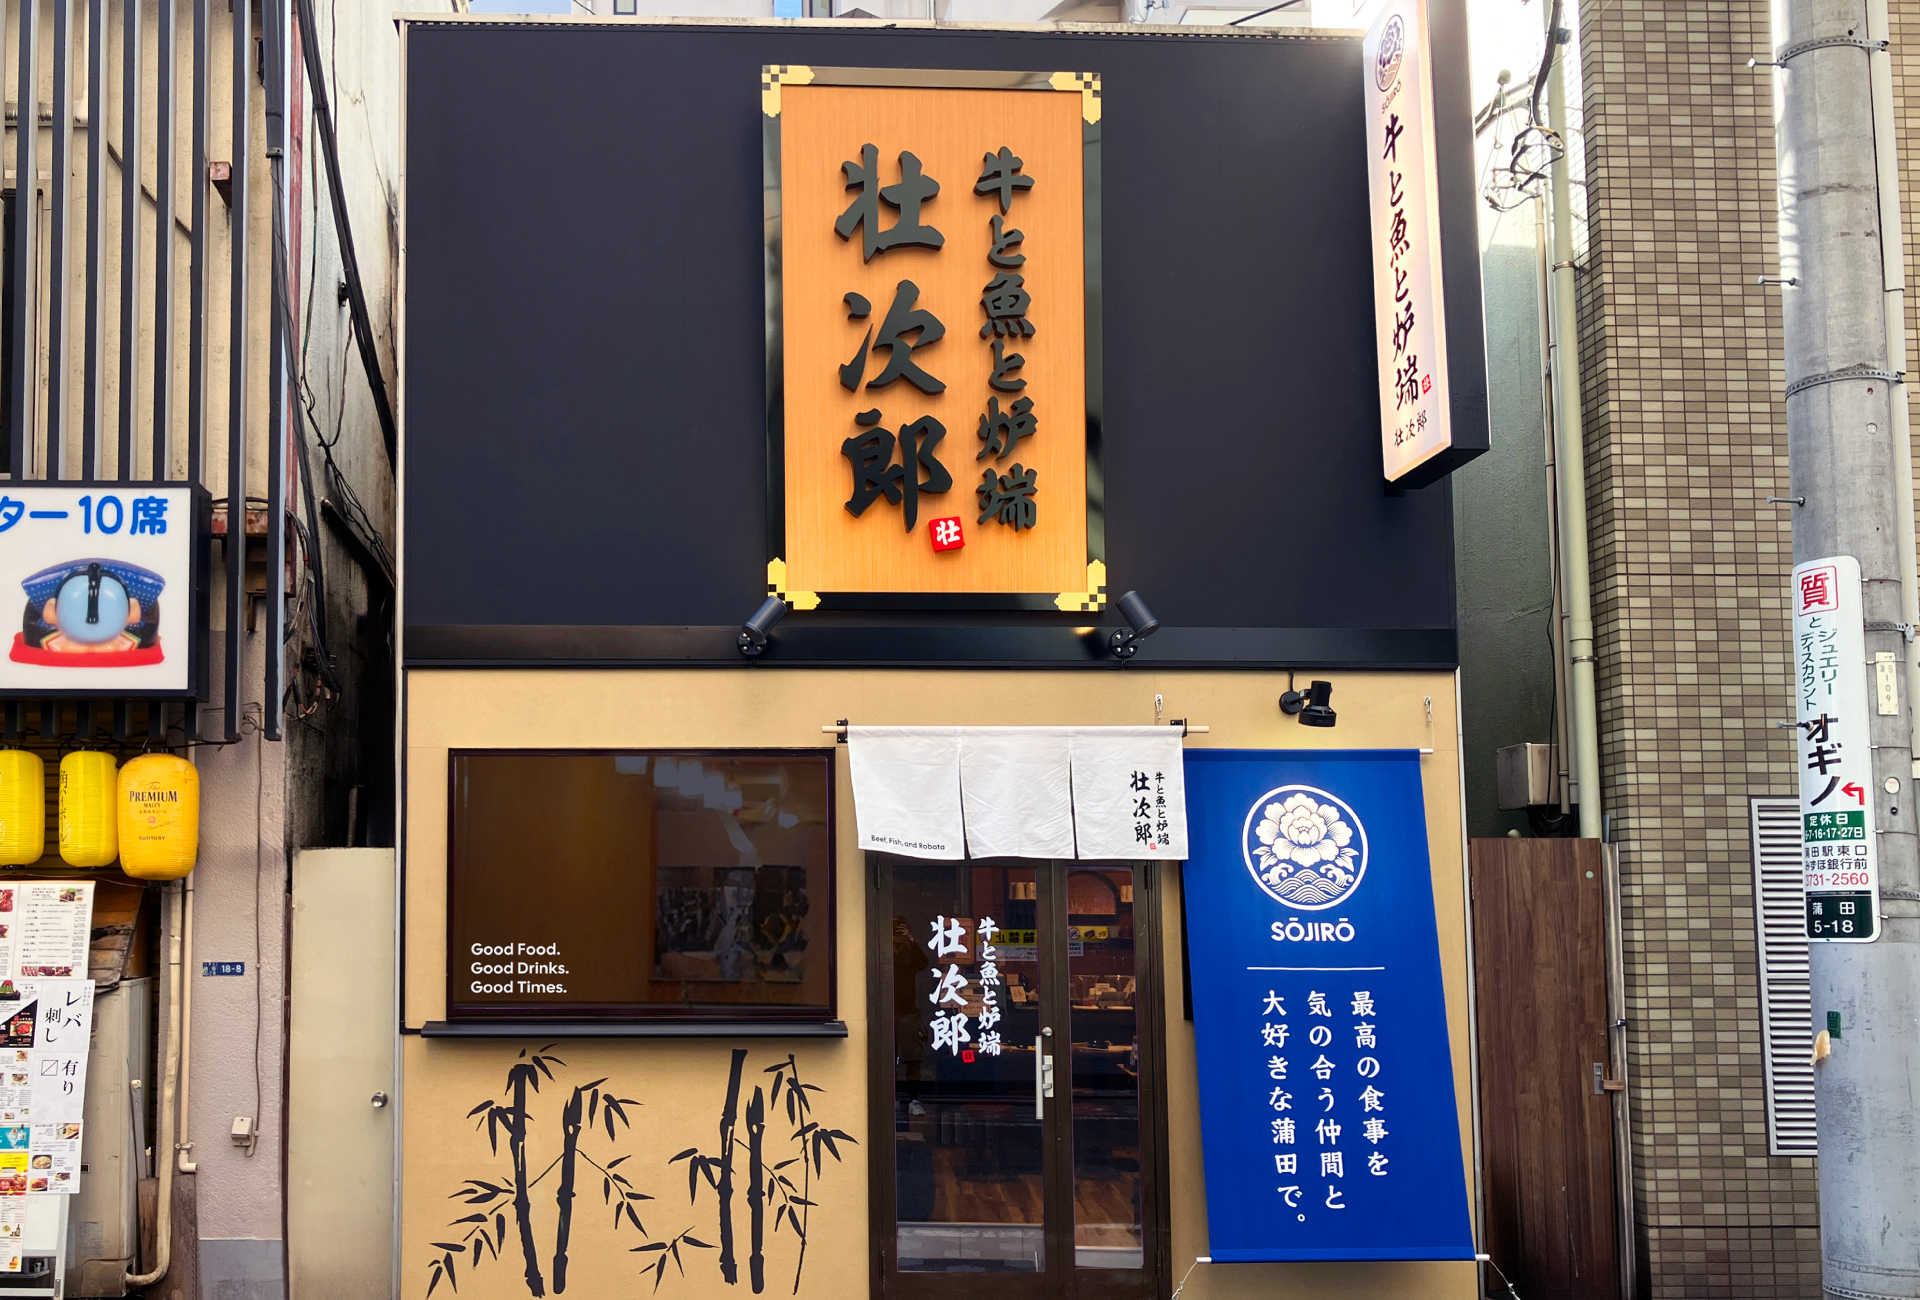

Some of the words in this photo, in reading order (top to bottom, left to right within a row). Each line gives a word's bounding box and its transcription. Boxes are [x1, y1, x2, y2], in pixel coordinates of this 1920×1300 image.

[1383, 113, 1419, 411] 牛と魚と炉端
[834, 143, 952, 532] 壮次郎
[973, 146, 1038, 532] 牛と魚と炉端
[1394, 410, 1427, 448] 壮次郎
[0, 496, 168, 535] ター10席
[936, 520, 960, 545] 壮
[1801, 572, 1830, 610] 質
[1809, 617, 1821, 628] と
[1801, 632, 1816, 711] ディスカウント
[1818, 628, 1839, 695] ジュエリー
[1807, 713, 1842, 807] オギノ
[129, 790, 177, 802] PREMIUM
[1130, 770, 1152, 845] 壮次郎
[1155, 771, 1169, 845] 牛と魚と炉端
[1809, 814, 1848, 827] 定休日
[871, 835, 887, 844] Beef,
[889, 838, 904, 847] Fish,
[1812, 901, 1855, 915] 蒲田
[1814, 919, 1854, 933] 5-18
[1271, 917, 1355, 942] SŌJIRŌ
[221, 964, 242, 973] 18-8
[471, 943, 514, 956] Good
[518, 943, 561, 956] Food.
[471, 962, 514, 974] Good
[517, 962, 570, 974] Drinks.
[471, 981, 514, 993] Good
[517, 981, 568, 993] Times.
[928, 915, 971, 1057] 壮次郎
[977, 916, 1001, 1057] 牛と魚と炉端
[45, 1007, 61, 1043] 刺し
[62, 991, 82, 1028] レバ
[61, 1060, 79, 1096] 有り
[1351, 991, 1389, 1176] 最高の食事を
[1261, 990, 1306, 1222] 大好きな蒲田で。
[1307, 990, 1346, 1209] 気の合う仲間と
